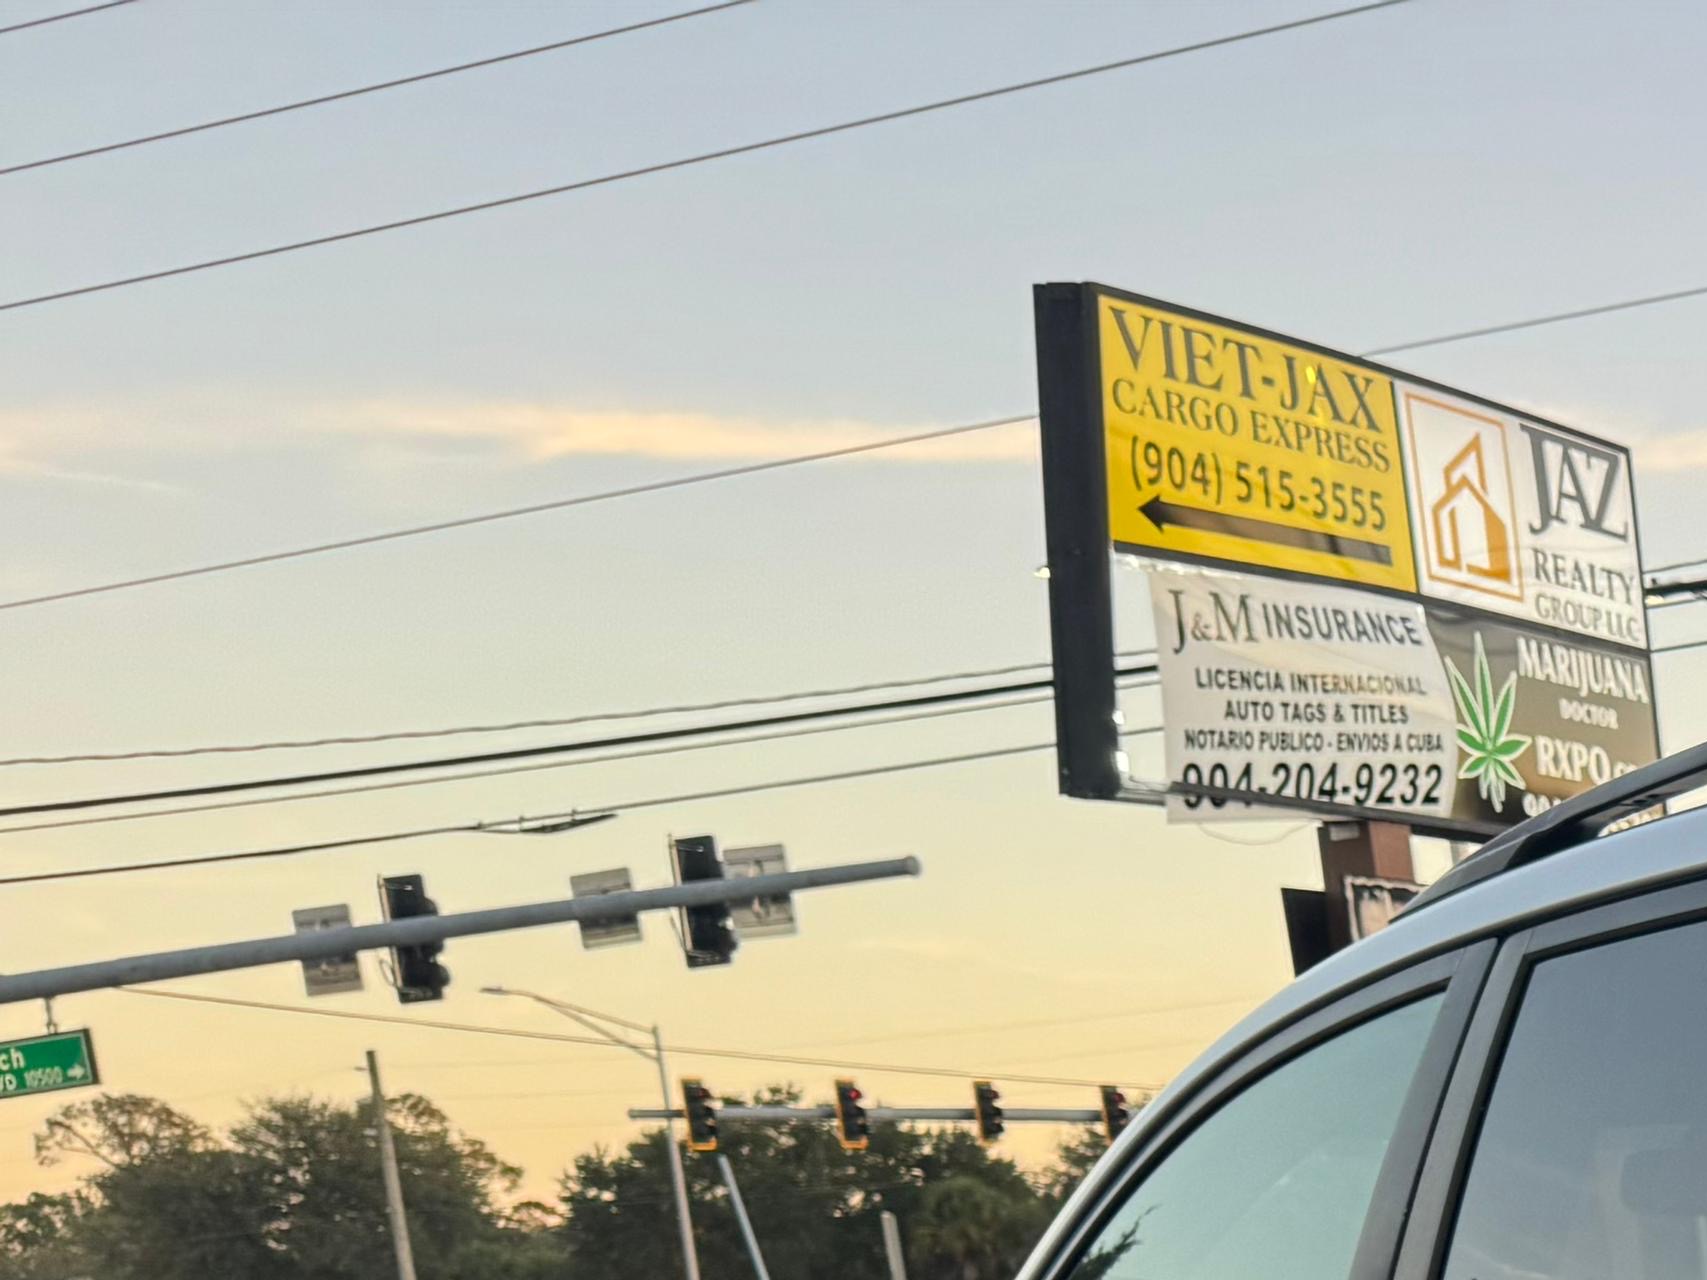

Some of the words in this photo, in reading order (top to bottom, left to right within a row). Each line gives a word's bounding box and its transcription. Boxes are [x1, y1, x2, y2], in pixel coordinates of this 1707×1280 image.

[1108, 305, 1383, 434] VIET-JAX
[1111, 377, 1240, 437] CARGO
[1250, 410, 1391, 474] EXPRESS
[1131, 435, 1223, 506] (904)
[1235, 460, 1387, 533] 515-3555
[1519, 422, 1629, 543] JAZ
[1531, 547, 1636, 605] REALTY
[1168, 589, 1260, 655] J&M
[1262, 602, 1425, 647] INSURANCE
[1535, 592, 1603, 632] GROUP
[1604, 609, 1640, 642] LLC
[1195, 667, 1284, 692] LICENCIA
[1290, 673, 1428, 697] INTERNACIONAL
[1516, 635, 1650, 705] MARIJUANA
[1183, 728, 1254, 751] NOTARIO
[1258, 730, 1325, 752] PUBLICO
[1336, 732, 1390, 753] ENVIOS
[1392, 733, 1402, 752] A
[1405, 733, 1444, 753] CUBA
[1224, 700, 1274, 722] AUTO
[1281, 701, 1327, 724] TAGS
[1333, 703, 1345, 724] &
[1351, 703, 1410, 725] TITLES
[1559, 697, 1620, 730] DOCTOR
[1181, 761, 1444, 811] 904-204-9232
